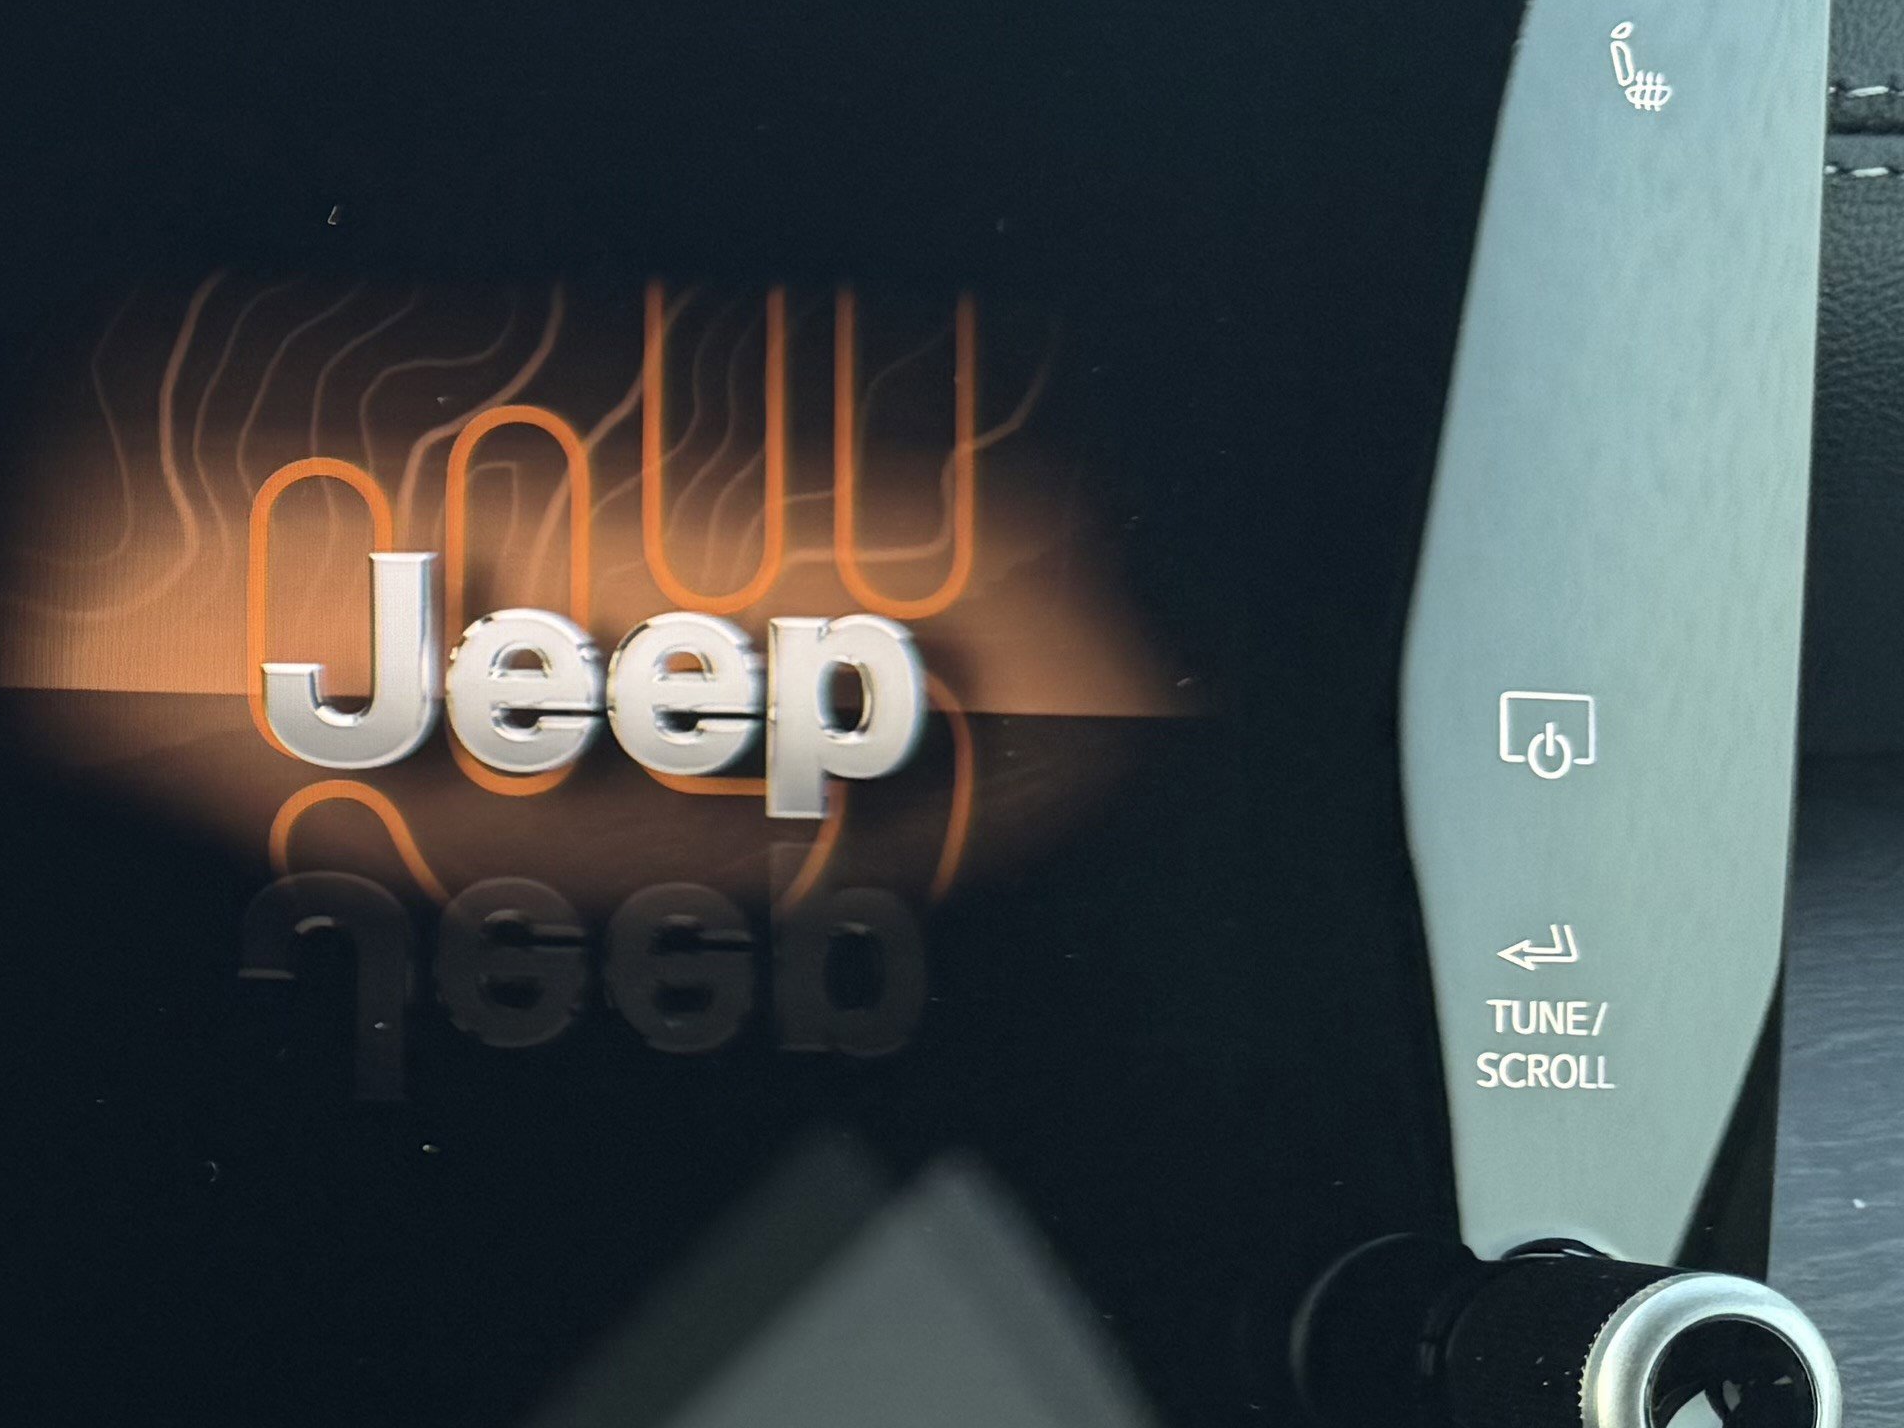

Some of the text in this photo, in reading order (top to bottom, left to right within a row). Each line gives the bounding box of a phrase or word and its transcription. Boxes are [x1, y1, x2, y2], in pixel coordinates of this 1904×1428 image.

[259, 548, 927, 820] Jeep
[1485, 998, 1609, 1037] TUNE/
[1475, 1050, 1617, 1090] SCROLL
